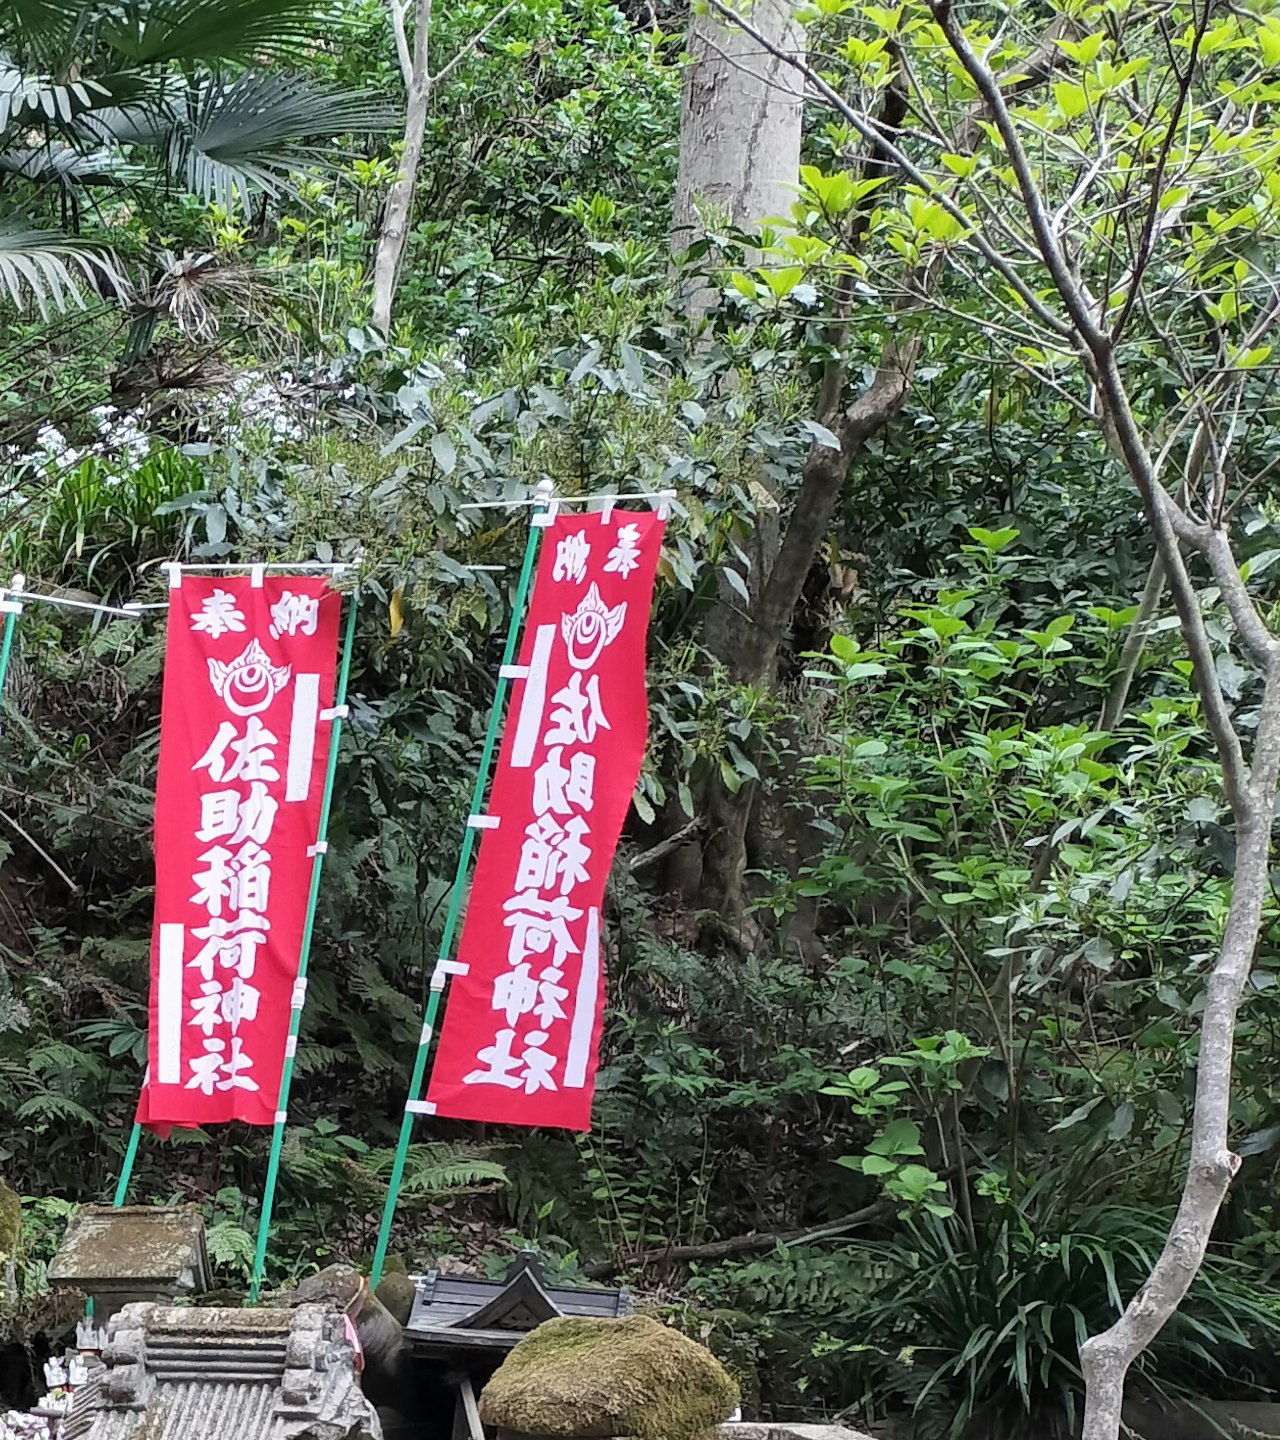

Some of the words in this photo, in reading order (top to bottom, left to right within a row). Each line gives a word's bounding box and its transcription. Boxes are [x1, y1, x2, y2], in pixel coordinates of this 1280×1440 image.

[190, 588, 319, 640] 奉納
[186, 716, 281, 1095] 佐助稲荷神社
